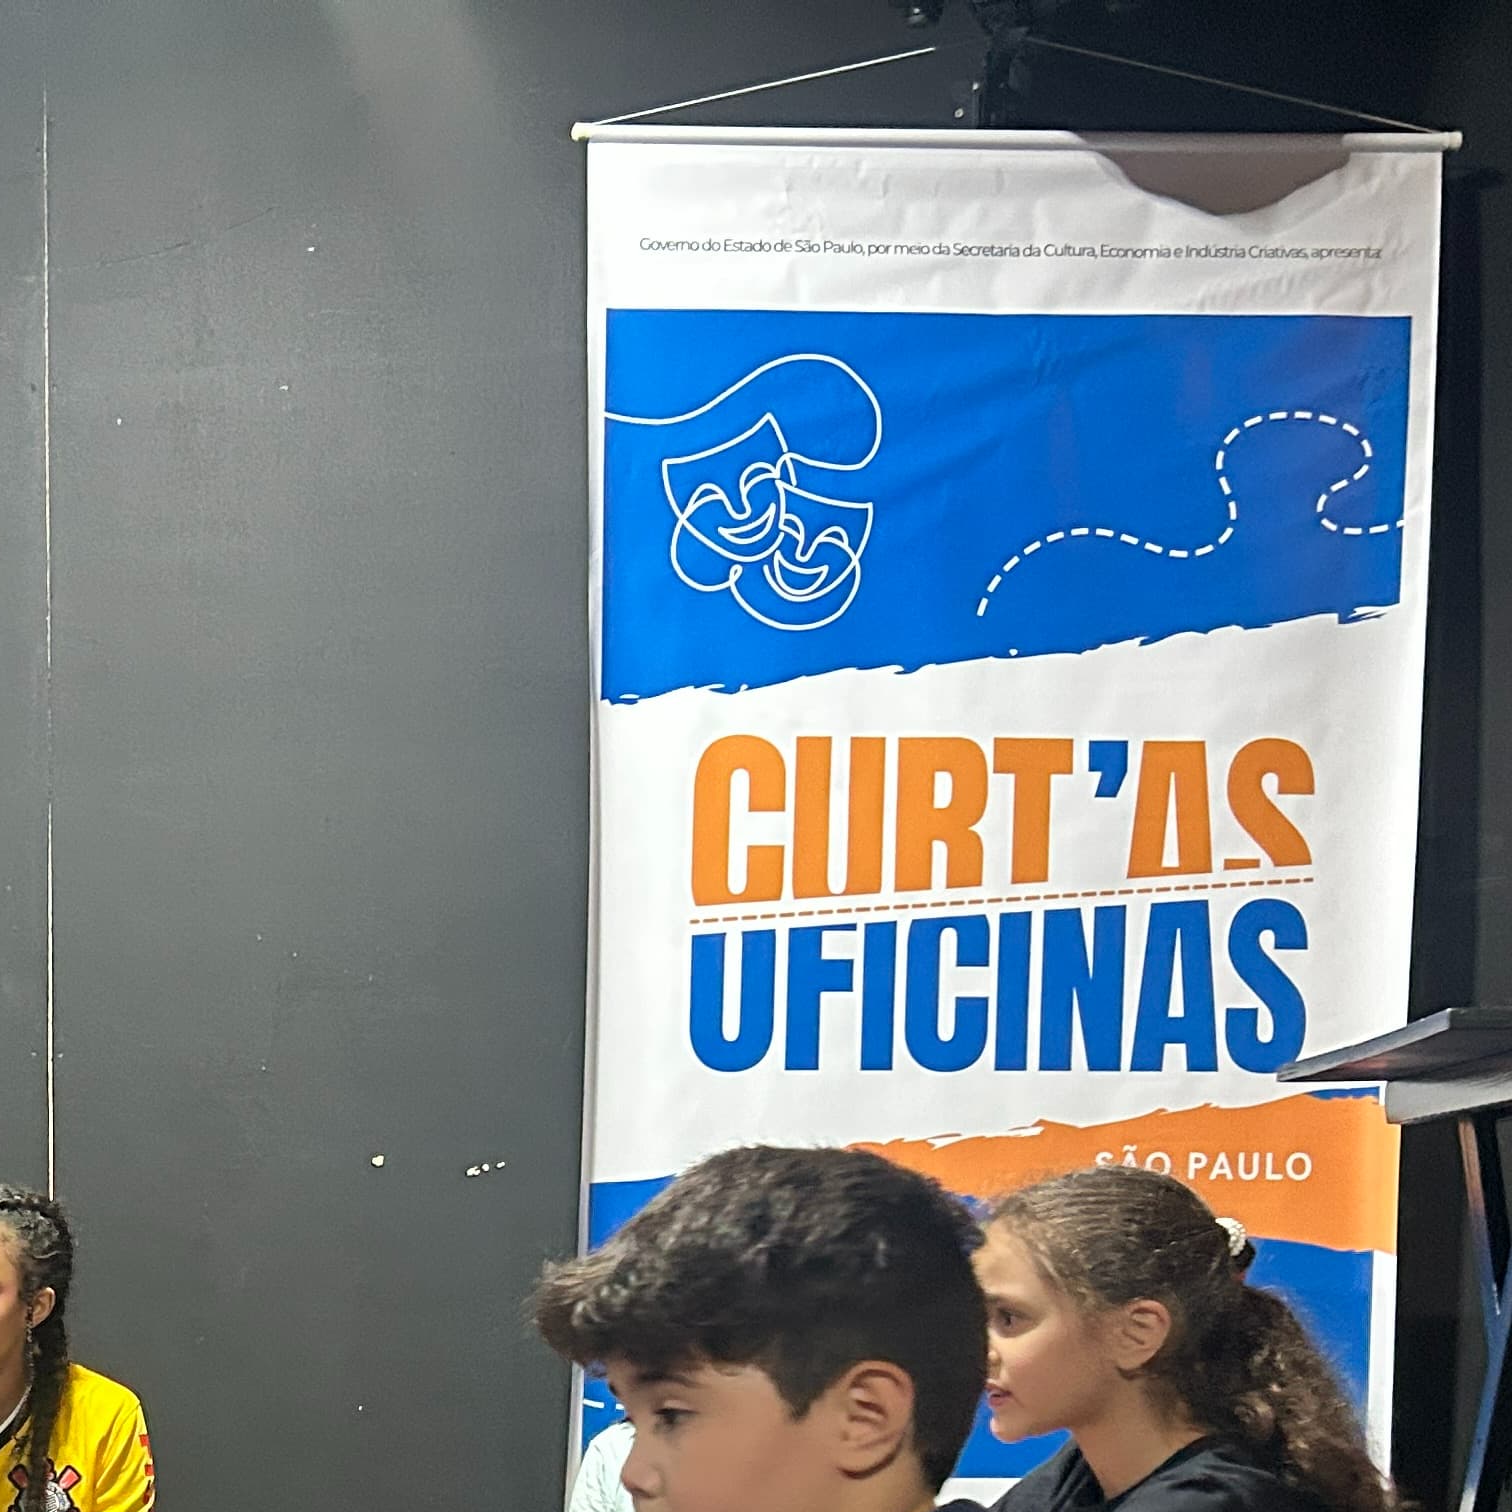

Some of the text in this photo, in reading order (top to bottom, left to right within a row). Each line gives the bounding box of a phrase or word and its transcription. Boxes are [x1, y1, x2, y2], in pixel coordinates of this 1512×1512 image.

[639, 237, 699, 252] Governo
[701, 237, 721, 252] do
[724, 238, 771, 253] Estado
[773, 238, 793, 253] de
[794, 239, 821, 254] São
[823, 240, 866, 257] Paulo,
[868, 244, 892, 257] por
[894, 243, 930, 256] meio
[932, 242, 951, 256] da
[952, 242, 1021, 257] Secretaria
[1022, 243, 1042, 258] da
[1044, 243, 1098, 260] Cultura,
[1100, 244, 1172, 259] Economia
[1173, 248, 1183, 258] e
[1186, 244, 1246, 259] Indústria
[1187, 1152, 1313, 1181] PAULO
